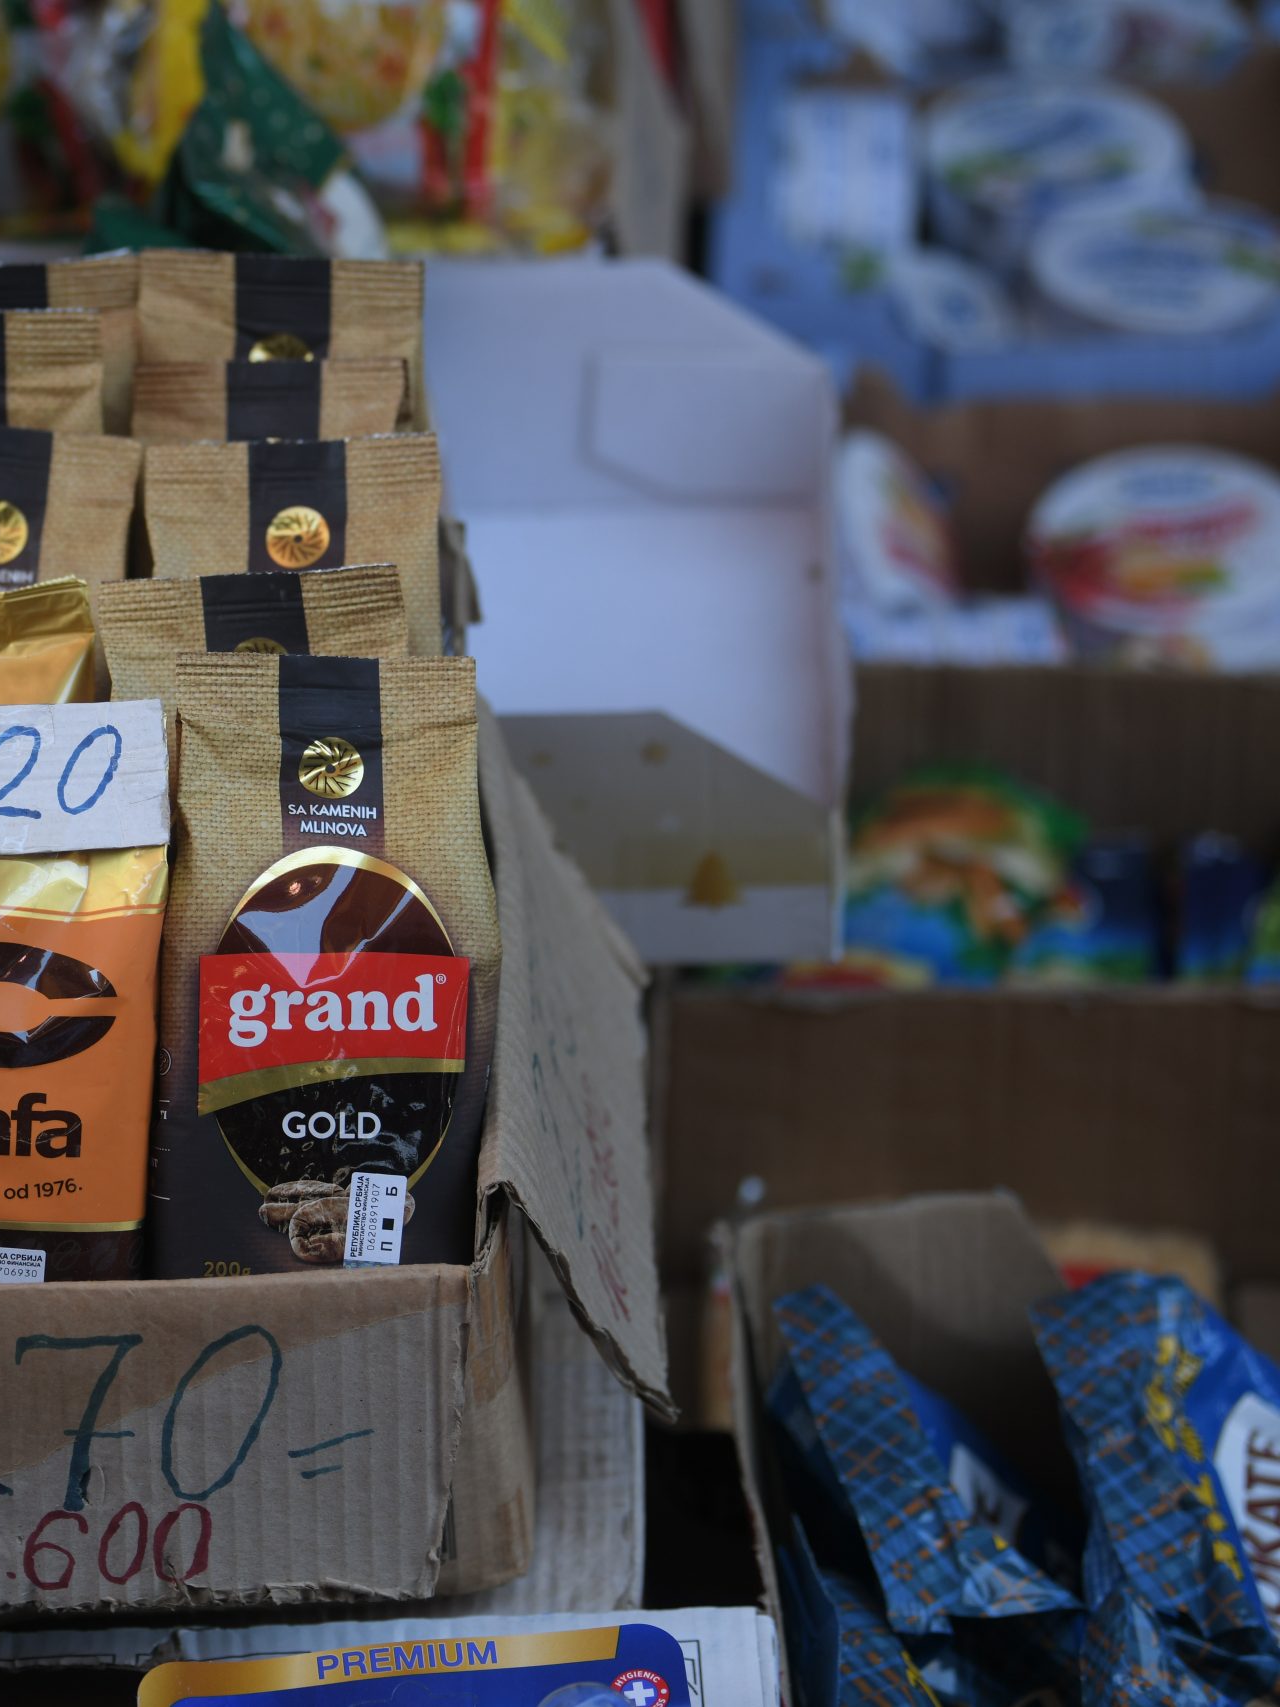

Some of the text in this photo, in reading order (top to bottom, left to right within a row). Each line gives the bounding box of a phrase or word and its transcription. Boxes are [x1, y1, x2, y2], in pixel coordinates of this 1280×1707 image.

[287, 803, 377, 820] SA KAMENIH
[300, 820, 368, 837] MLINOVA
[228, 973, 438, 1047] grand
[281, 1111, 382, 1139] GOLD
[3, 1183, 29, 1200] od
[33, 1178, 83, 1199] 1976.
[350, 1175, 365, 1257] РЕПУБЛИКА СРБИЈА
[367, 1183, 381, 1251] 0620891907
[10, 1253, 43, 1262] СРБИЈА
[316, 1640, 498, 1680] PREMIUM
[614, 1670, 661, 1687] HYGIENIC
